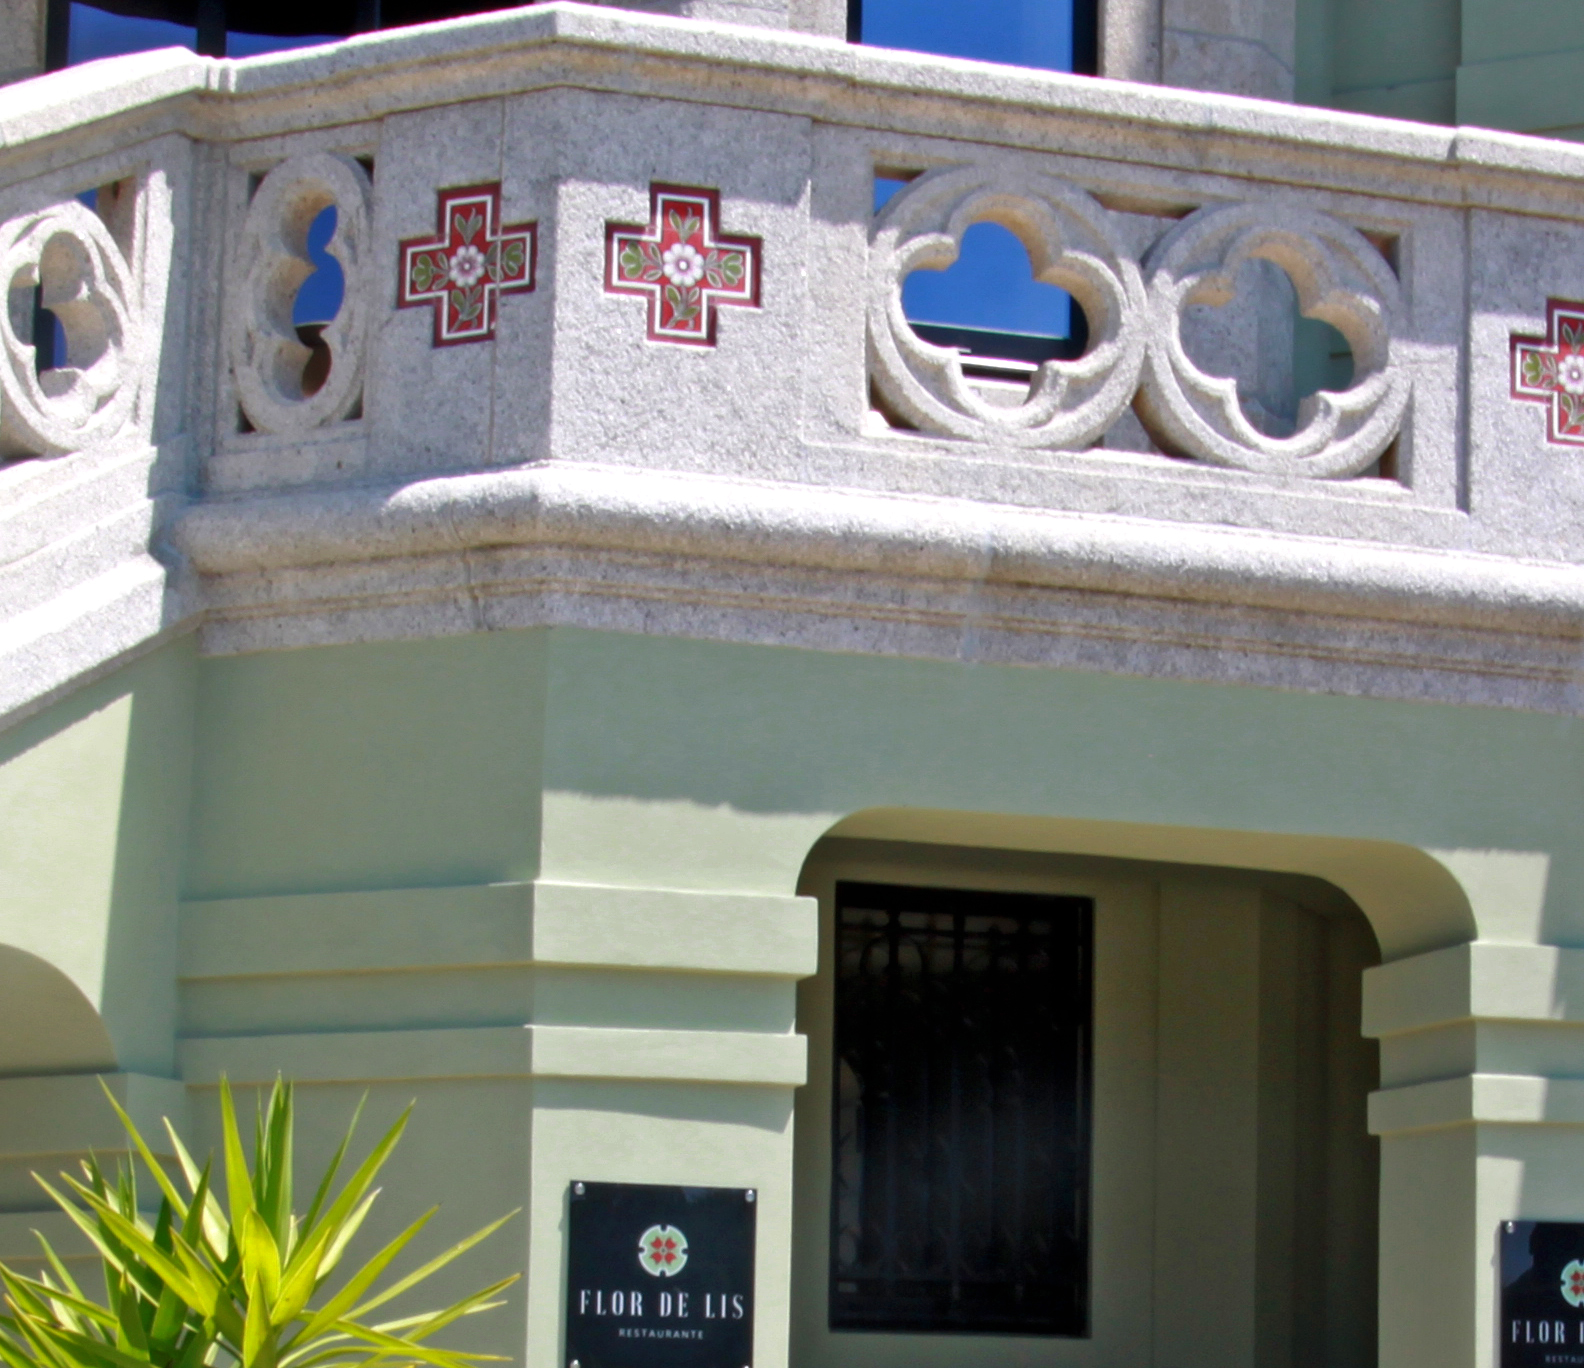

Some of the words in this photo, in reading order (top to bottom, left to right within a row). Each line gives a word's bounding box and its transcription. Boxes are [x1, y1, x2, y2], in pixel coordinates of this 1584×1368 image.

[579, 1289, 644, 1317] FLOR
[659, 1291, 689, 1318] DE
[705, 1293, 744, 1320] LIS
[618, 1327, 704, 1340] RESTAURANTE
[1511, 1319, 1566, 1344] FLOR
